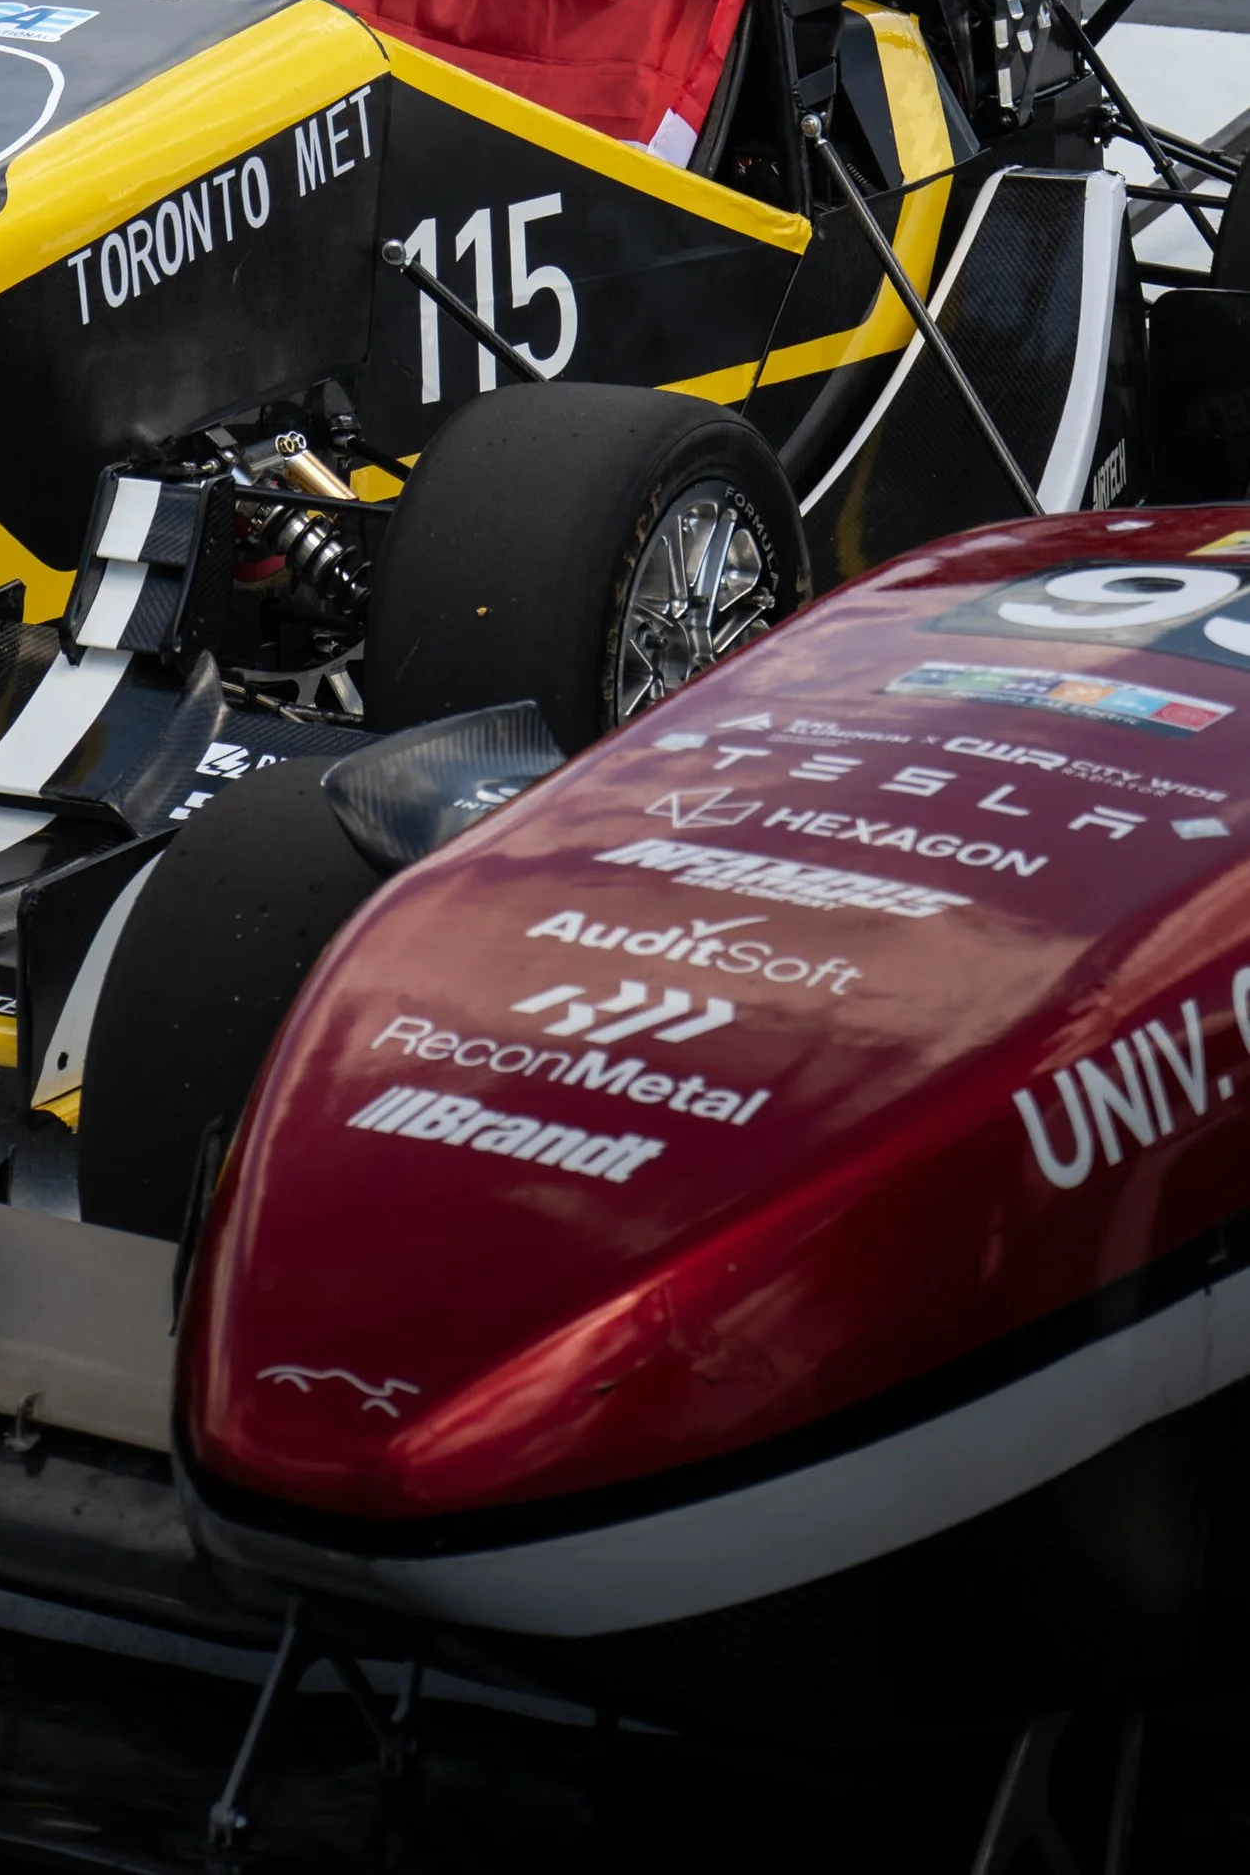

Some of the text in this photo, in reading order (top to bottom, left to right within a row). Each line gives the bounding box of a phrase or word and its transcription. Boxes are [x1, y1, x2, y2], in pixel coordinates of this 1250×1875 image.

[67, 85, 375, 325] TORONTO MET
[403, 192, 579, 405] 115
[724, 485, 780, 592] FORMULA
[1071, 760, 1143, 782] CITY
[1150, 777, 1230, 803] WIDE
[763, 806, 1050, 878] HEXAGON
[525, 910, 865, 997] AuditSoft
[370, 1014, 772, 1126] ReconMetal
[1012, 997, 1236, 1191] UNIV.
[405, 1090, 668, 1184] Brandt
